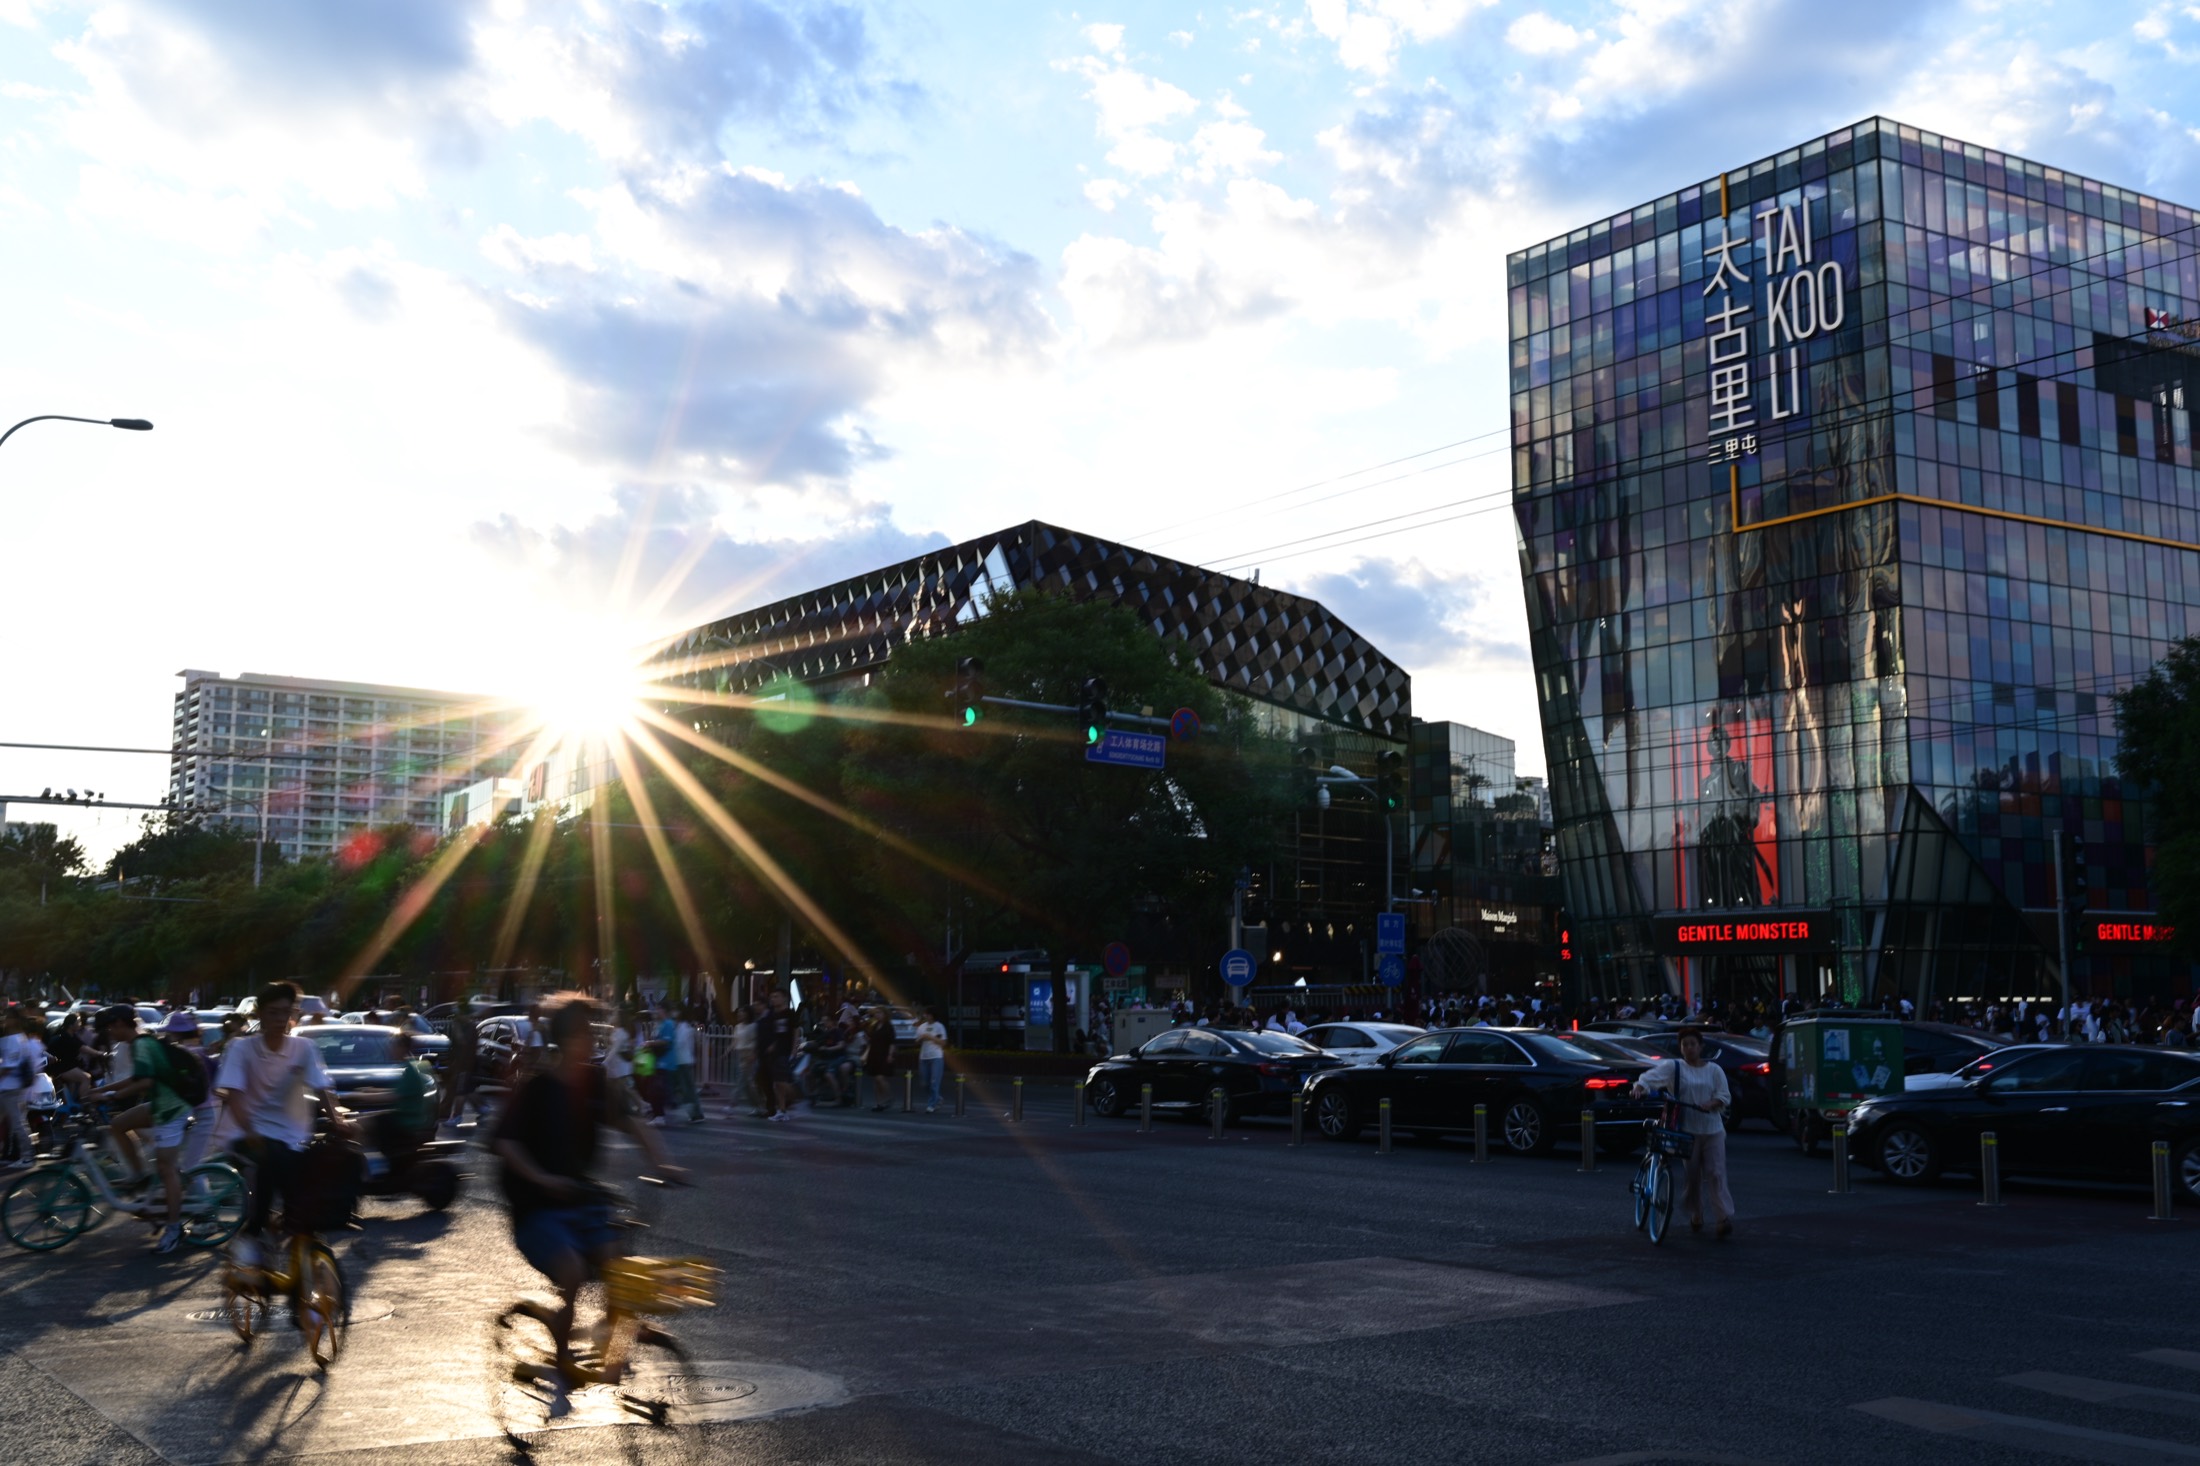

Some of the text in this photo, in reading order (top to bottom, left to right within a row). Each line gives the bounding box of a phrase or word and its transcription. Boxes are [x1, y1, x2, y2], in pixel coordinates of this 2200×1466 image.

[1755, 197, 1812, 276] TAI
[1703, 226, 1755, 436] 太古里
[1766, 261, 1844, 348] KOO
[1770, 346, 1800, 420] LI
[1707, 433, 1757, 465] 三里屯
[1110, 736, 1161, 753] 工人体育场北路
[1678, 922, 1809, 942] GENTLE MONSTER
[2097, 923, 2142, 941] GENTLE
